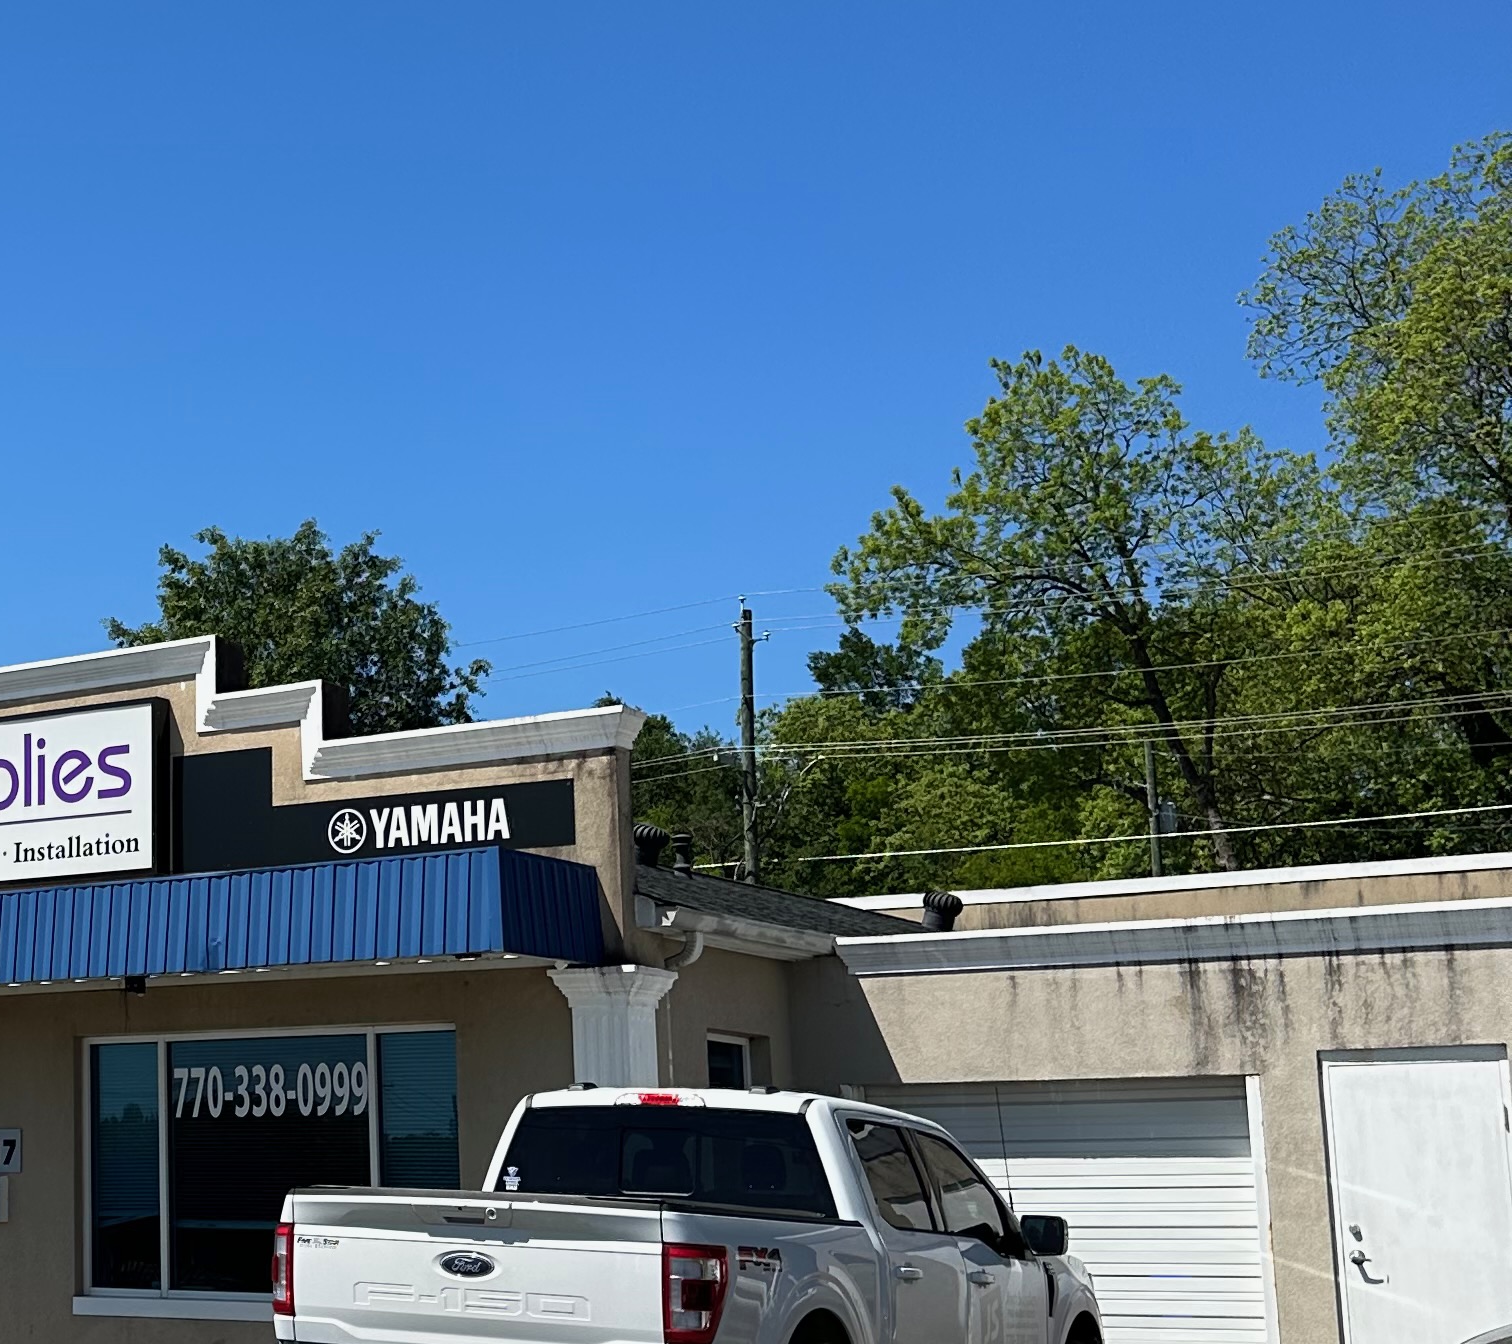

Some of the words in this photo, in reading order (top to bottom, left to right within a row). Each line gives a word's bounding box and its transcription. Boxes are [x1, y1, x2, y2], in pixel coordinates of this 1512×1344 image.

[369, 797, 510, 849] YAMAHA
[13, 832, 140, 864] Installation
[173, 1061, 368, 1119] 770-338-0999
[451, 1257, 483, 1273] Ford
[737, 1245, 783, 1273] FX4
[353, 1281, 592, 1322] F-150
